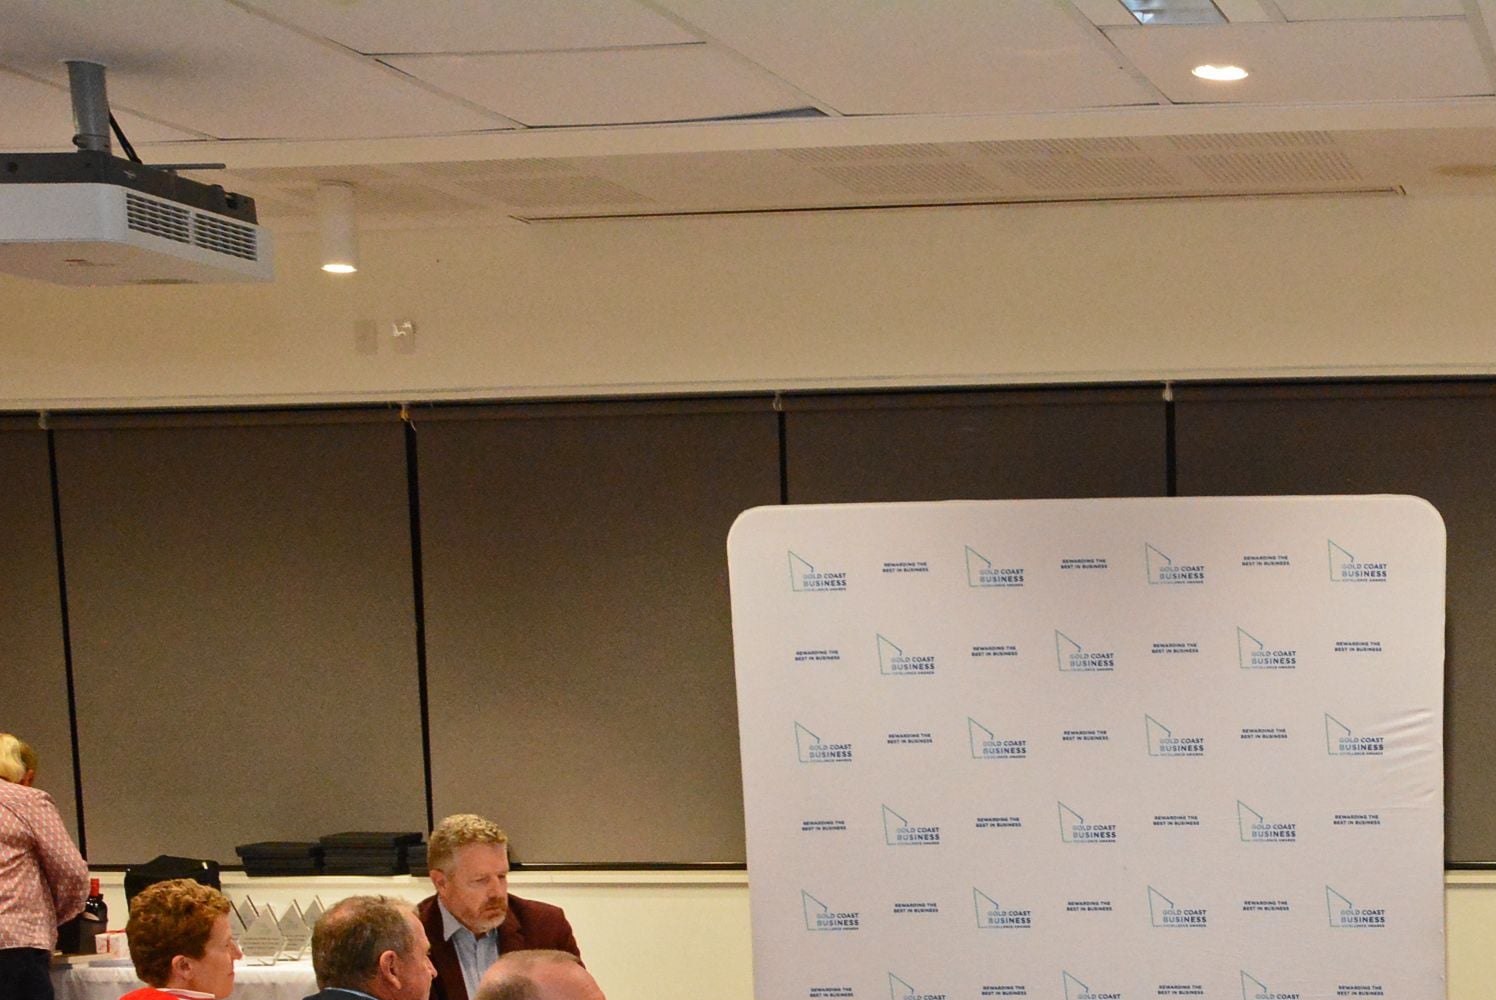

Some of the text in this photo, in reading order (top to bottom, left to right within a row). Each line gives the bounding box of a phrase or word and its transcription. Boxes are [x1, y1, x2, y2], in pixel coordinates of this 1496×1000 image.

[1160, 572, 1205, 580] BUSINESS
[1342, 570, 1388, 578] BUSINESS
[980, 575, 1025, 583] BUSINESS
[1251, 657, 1297, 665] BUSINESS
[891, 663, 935, 671] BUSINESS
[983, 747, 1027, 755] BUSINESS
[1073, 831, 1117, 839] BUSINESS
[1252, 830, 1297, 838] BUSINESS
[817, 919, 860, 927] BUSINESS
[988, 917, 1032, 925] BUSINESS
[1162, 916, 1207, 924] BUSINESS
[1341, 916, 1386, 924] BUSINESS
